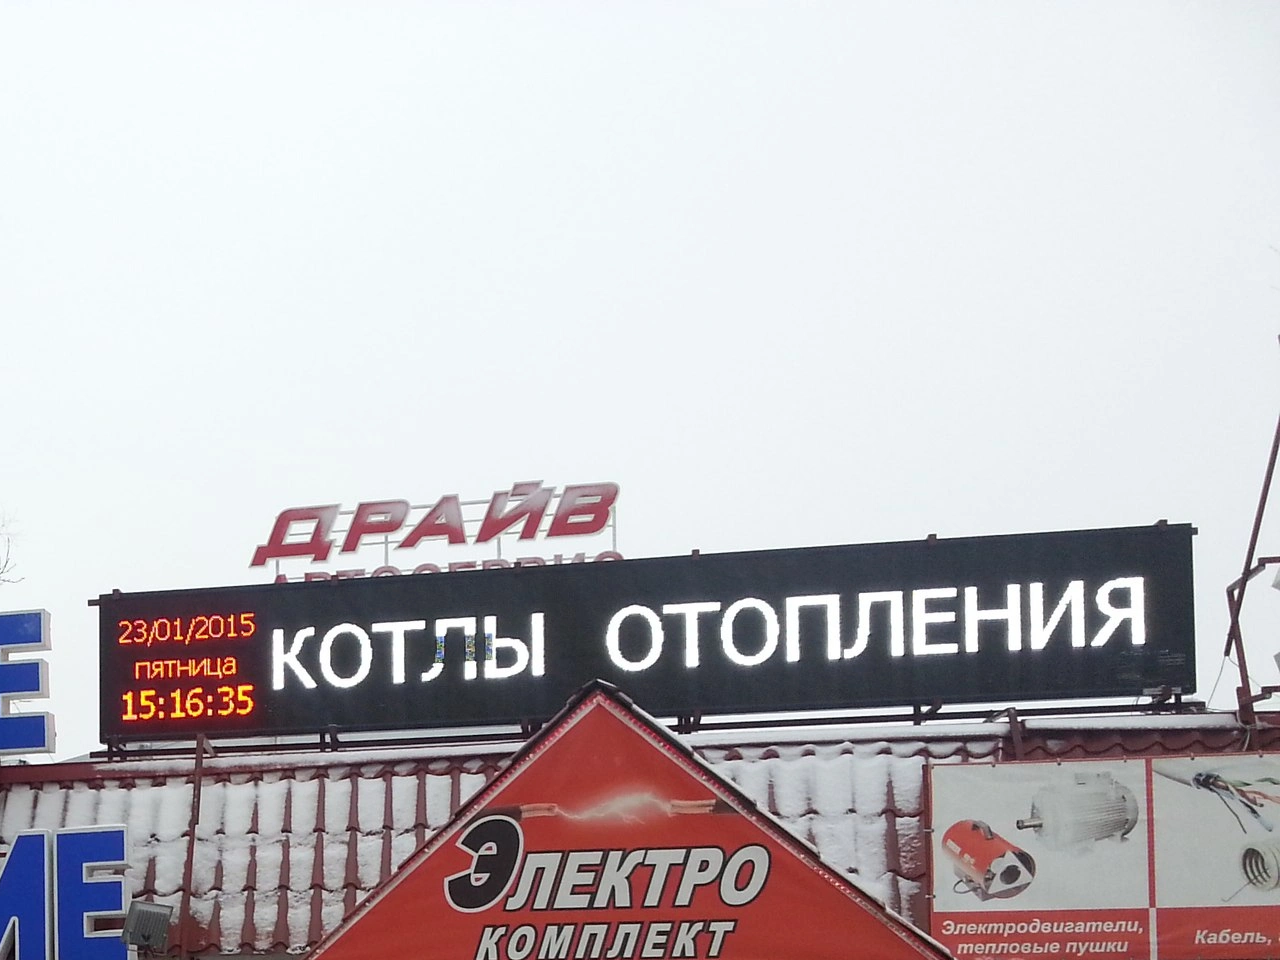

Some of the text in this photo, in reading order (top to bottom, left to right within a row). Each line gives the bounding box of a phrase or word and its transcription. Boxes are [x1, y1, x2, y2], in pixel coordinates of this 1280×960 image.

[249, 480, 620, 568] ДРАЙВ
[118, 613, 256, 647] 23/01/2015
[272, 576, 1146, 690] КОТЛЫ ОТОПЛЕНИЯ
[135, 657, 237, 680] пятница
[122, 684, 254, 721] 15:16:35
[443, 814, 772, 914] ЭЛЕКТРО
[942, 918, 1144, 936] Электродвигатели,
[1194, 928, 1272, 945] Кабель,
[957, 940, 1128, 957] тепловые пушки
